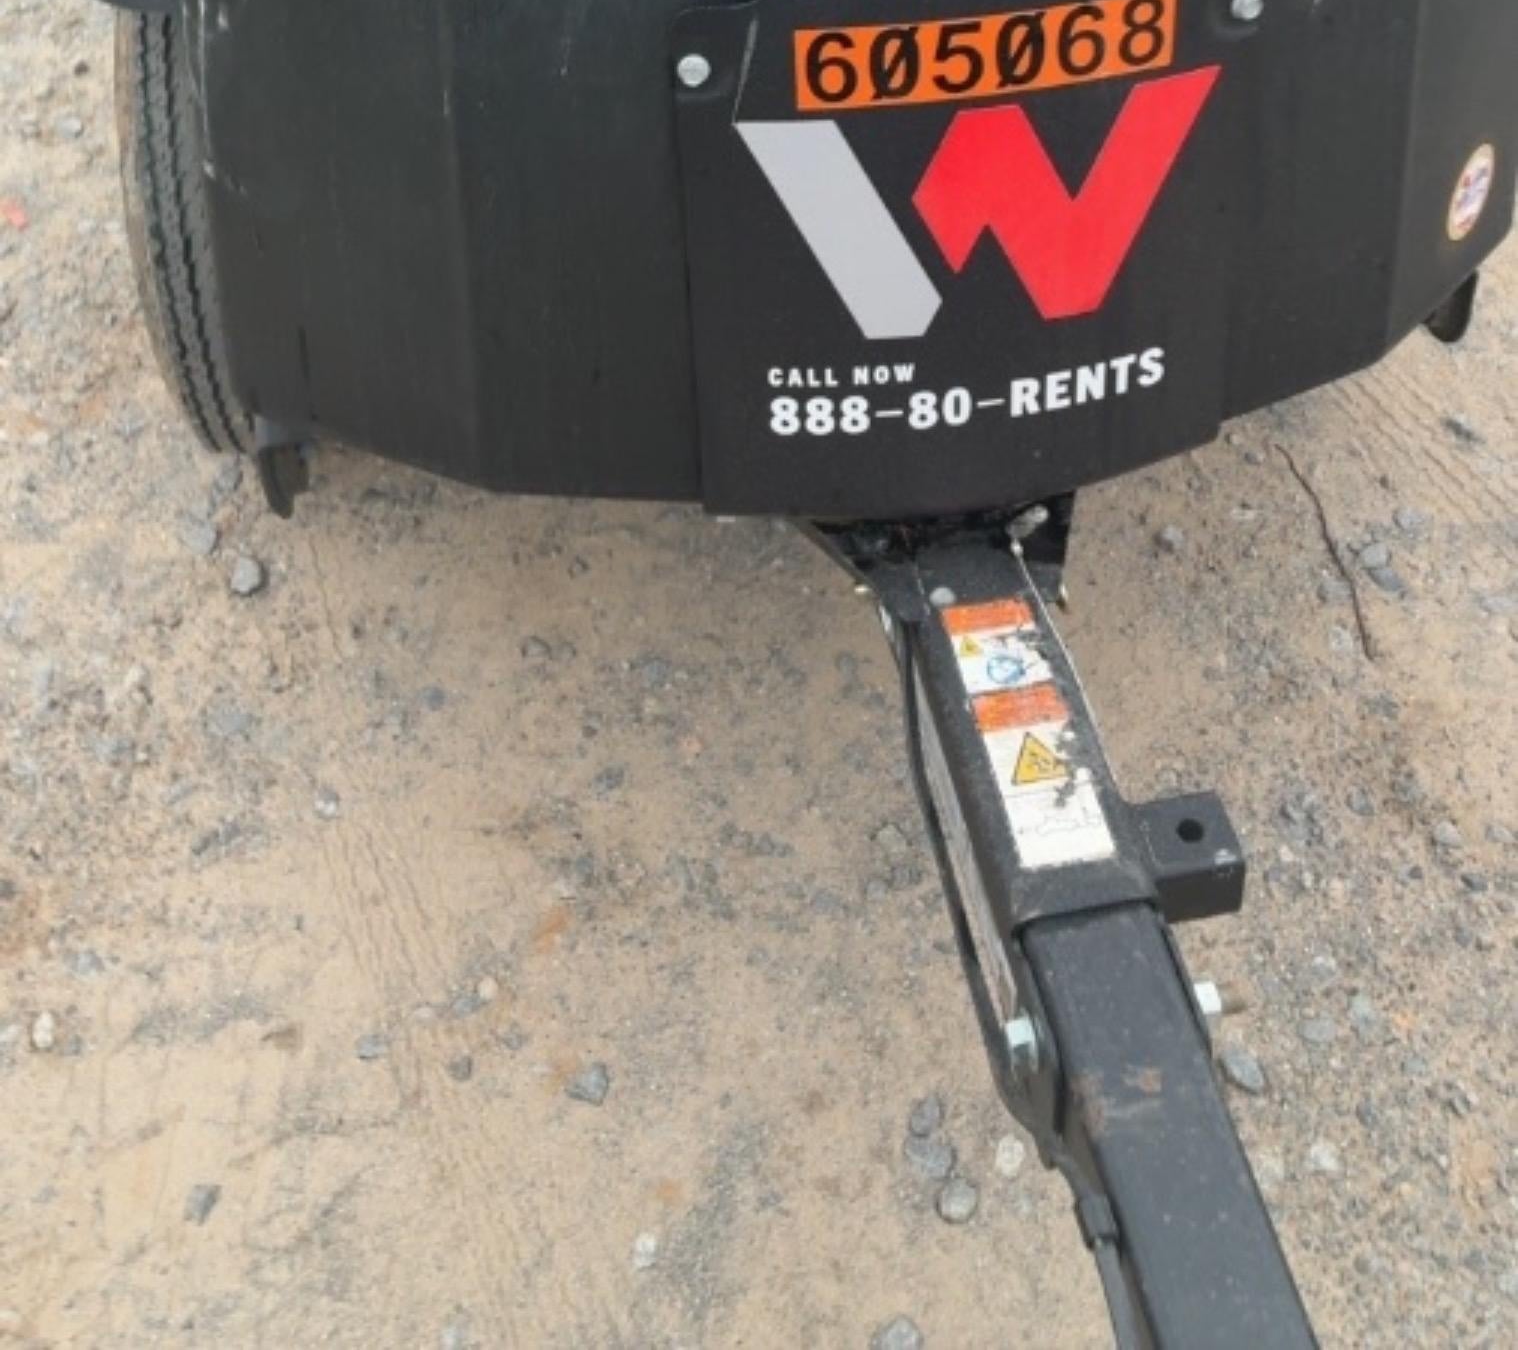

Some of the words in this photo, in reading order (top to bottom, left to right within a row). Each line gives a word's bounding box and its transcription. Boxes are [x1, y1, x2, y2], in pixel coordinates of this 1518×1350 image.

[767, 366, 839, 388] CALL
[853, 363, 916, 386] NOW
[769, 346, 1165, 436] 888-80-RENTS
